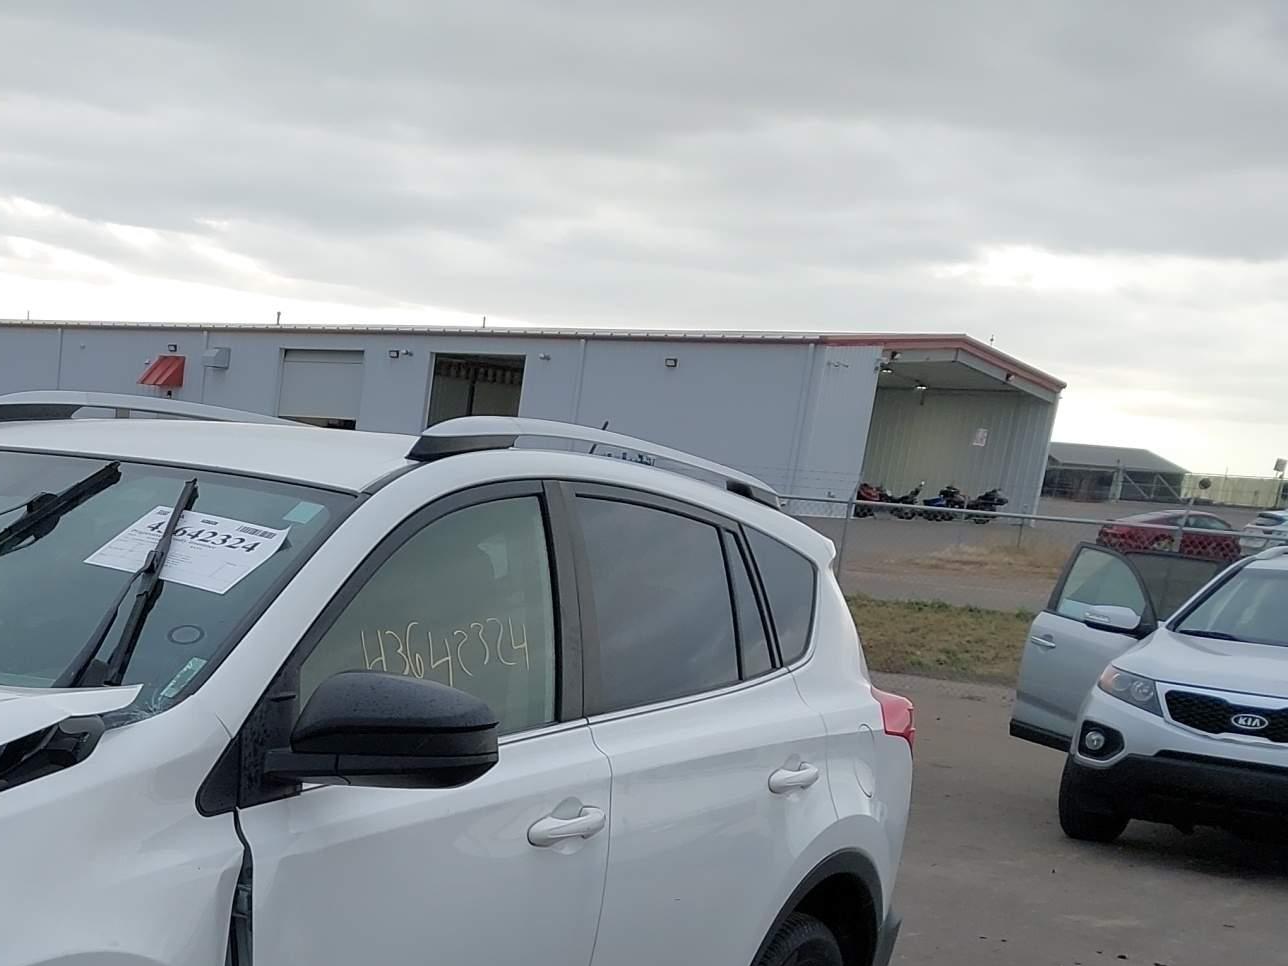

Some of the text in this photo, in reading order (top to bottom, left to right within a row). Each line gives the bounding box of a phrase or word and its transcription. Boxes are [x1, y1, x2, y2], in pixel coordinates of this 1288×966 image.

[146, 521, 261, 553] 4642324
[360, 616, 530, 688] 43642324
[1237, 716, 1261, 727] KIA
